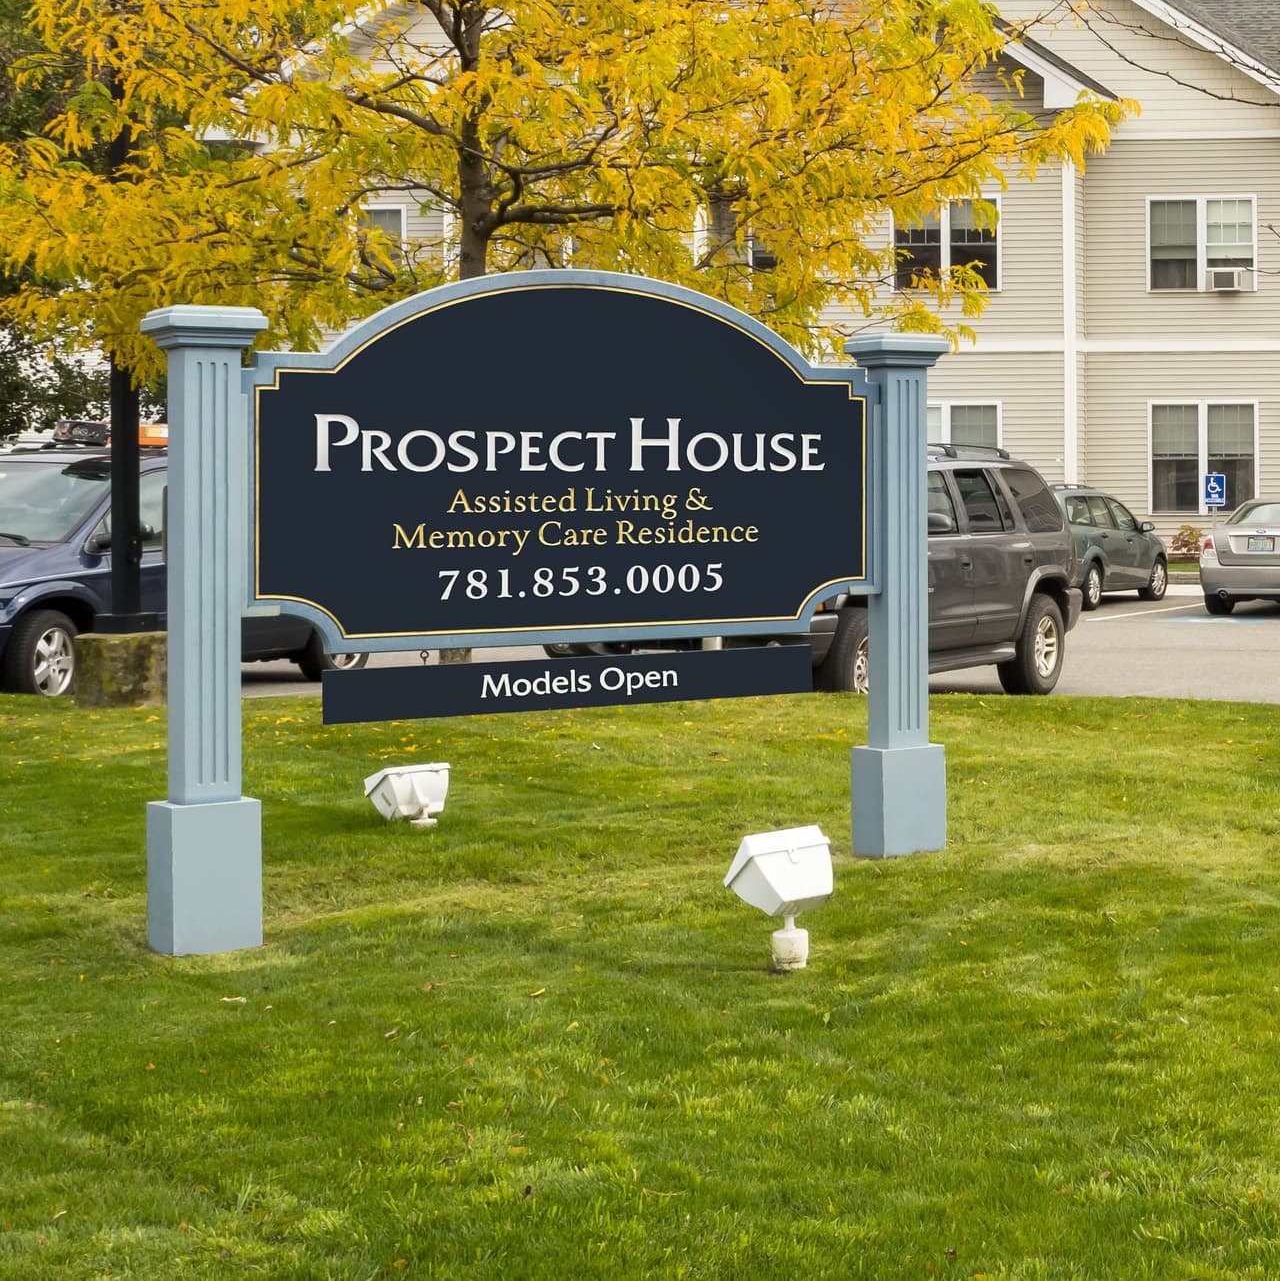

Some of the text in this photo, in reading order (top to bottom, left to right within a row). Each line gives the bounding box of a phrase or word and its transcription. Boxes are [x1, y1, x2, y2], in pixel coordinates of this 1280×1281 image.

[313, 413, 826, 472] PROSPECT HOUSE
[446, 487, 714, 520] Assisted Living &
[391, 519, 760, 556] Memory Care Residence
[438, 562, 724, 601] 781.853.0005
[480, 666, 679, 699] Models Open
